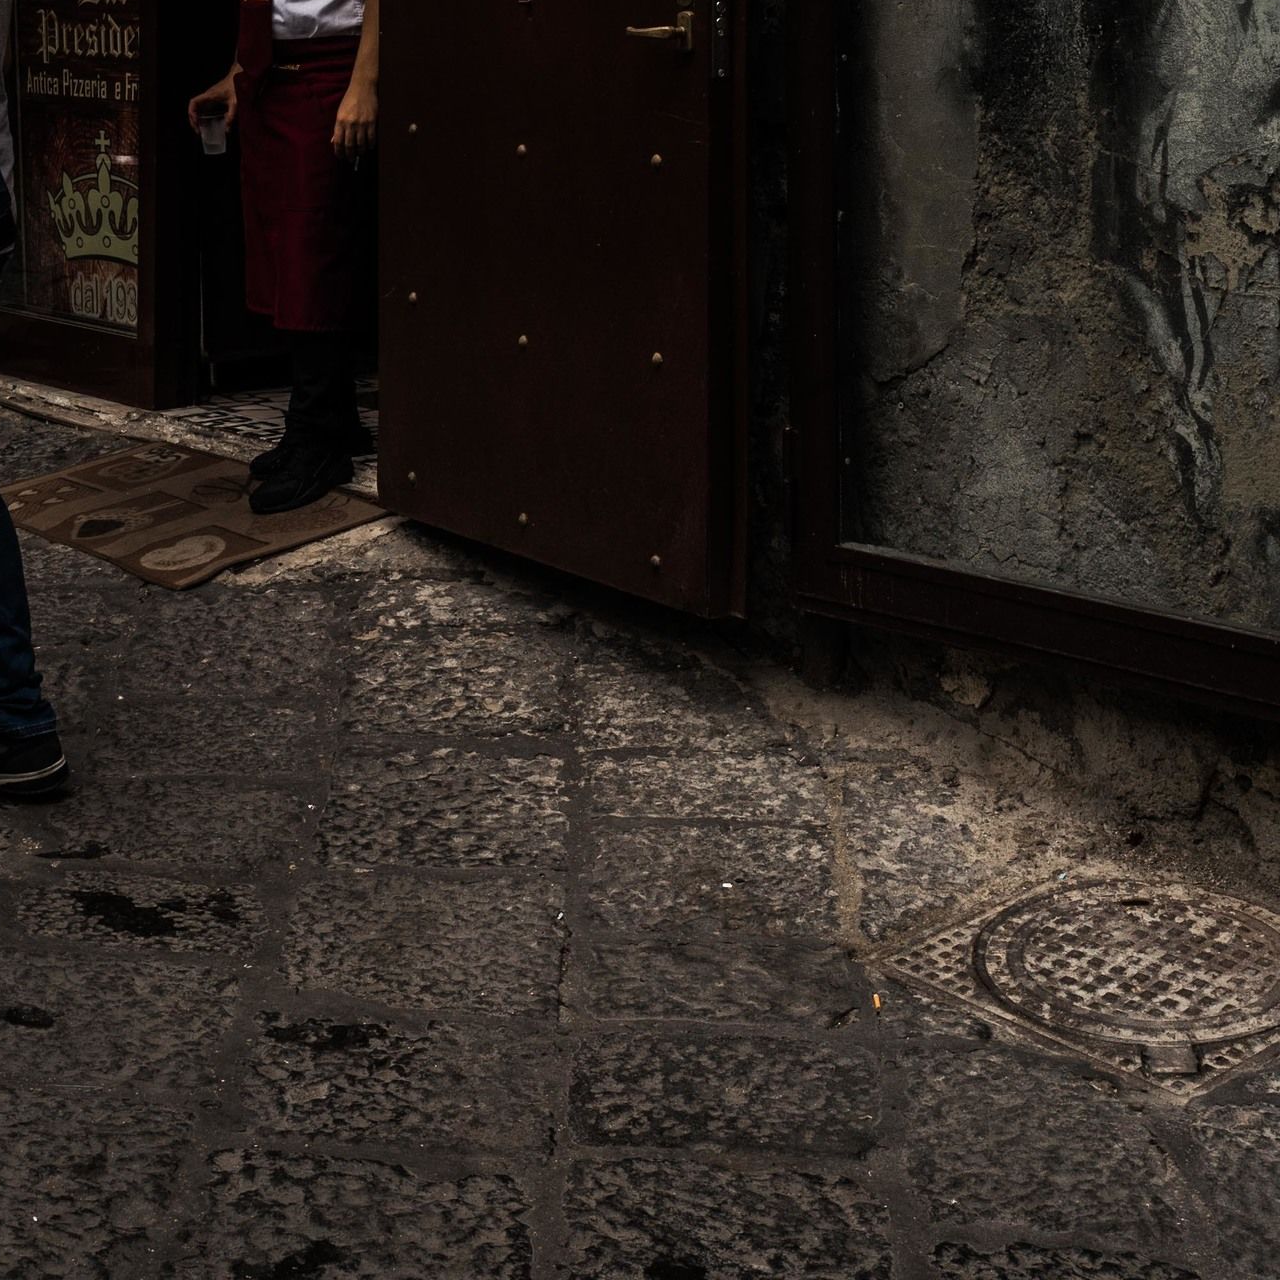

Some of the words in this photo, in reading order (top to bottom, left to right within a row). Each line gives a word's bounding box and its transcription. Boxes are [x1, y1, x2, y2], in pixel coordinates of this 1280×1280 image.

[26, 64, 60, 97] Antica
[62, 67, 108, 101] Pizzeria
[114, 80, 122, 101] e
[73, 272, 100, 315] dal
